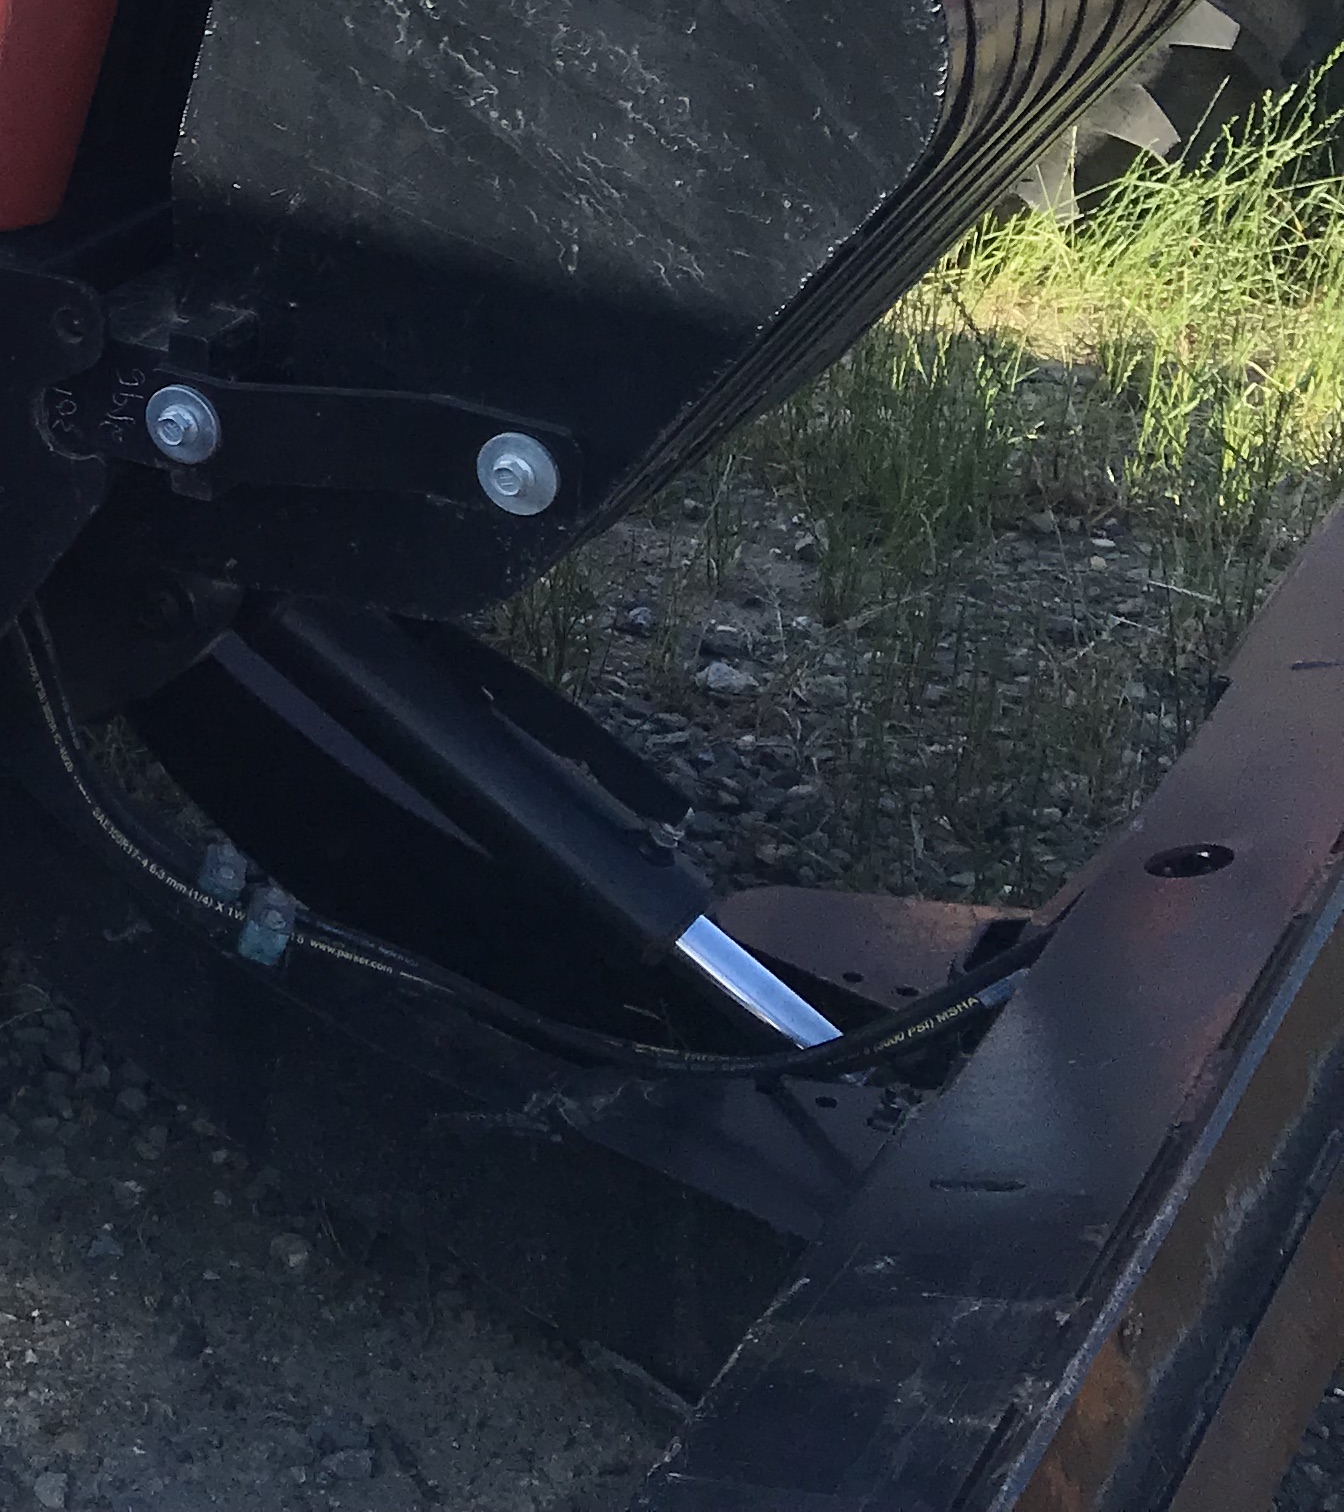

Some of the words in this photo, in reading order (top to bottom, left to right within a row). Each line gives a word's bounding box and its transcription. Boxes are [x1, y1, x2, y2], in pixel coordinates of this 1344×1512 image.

[166, 876, 187, 894] mm
[189, 888, 214, 908] (1/4)
[310, 939, 393, 974] www.parker.com
[935, 996, 980, 1023] MSHA
